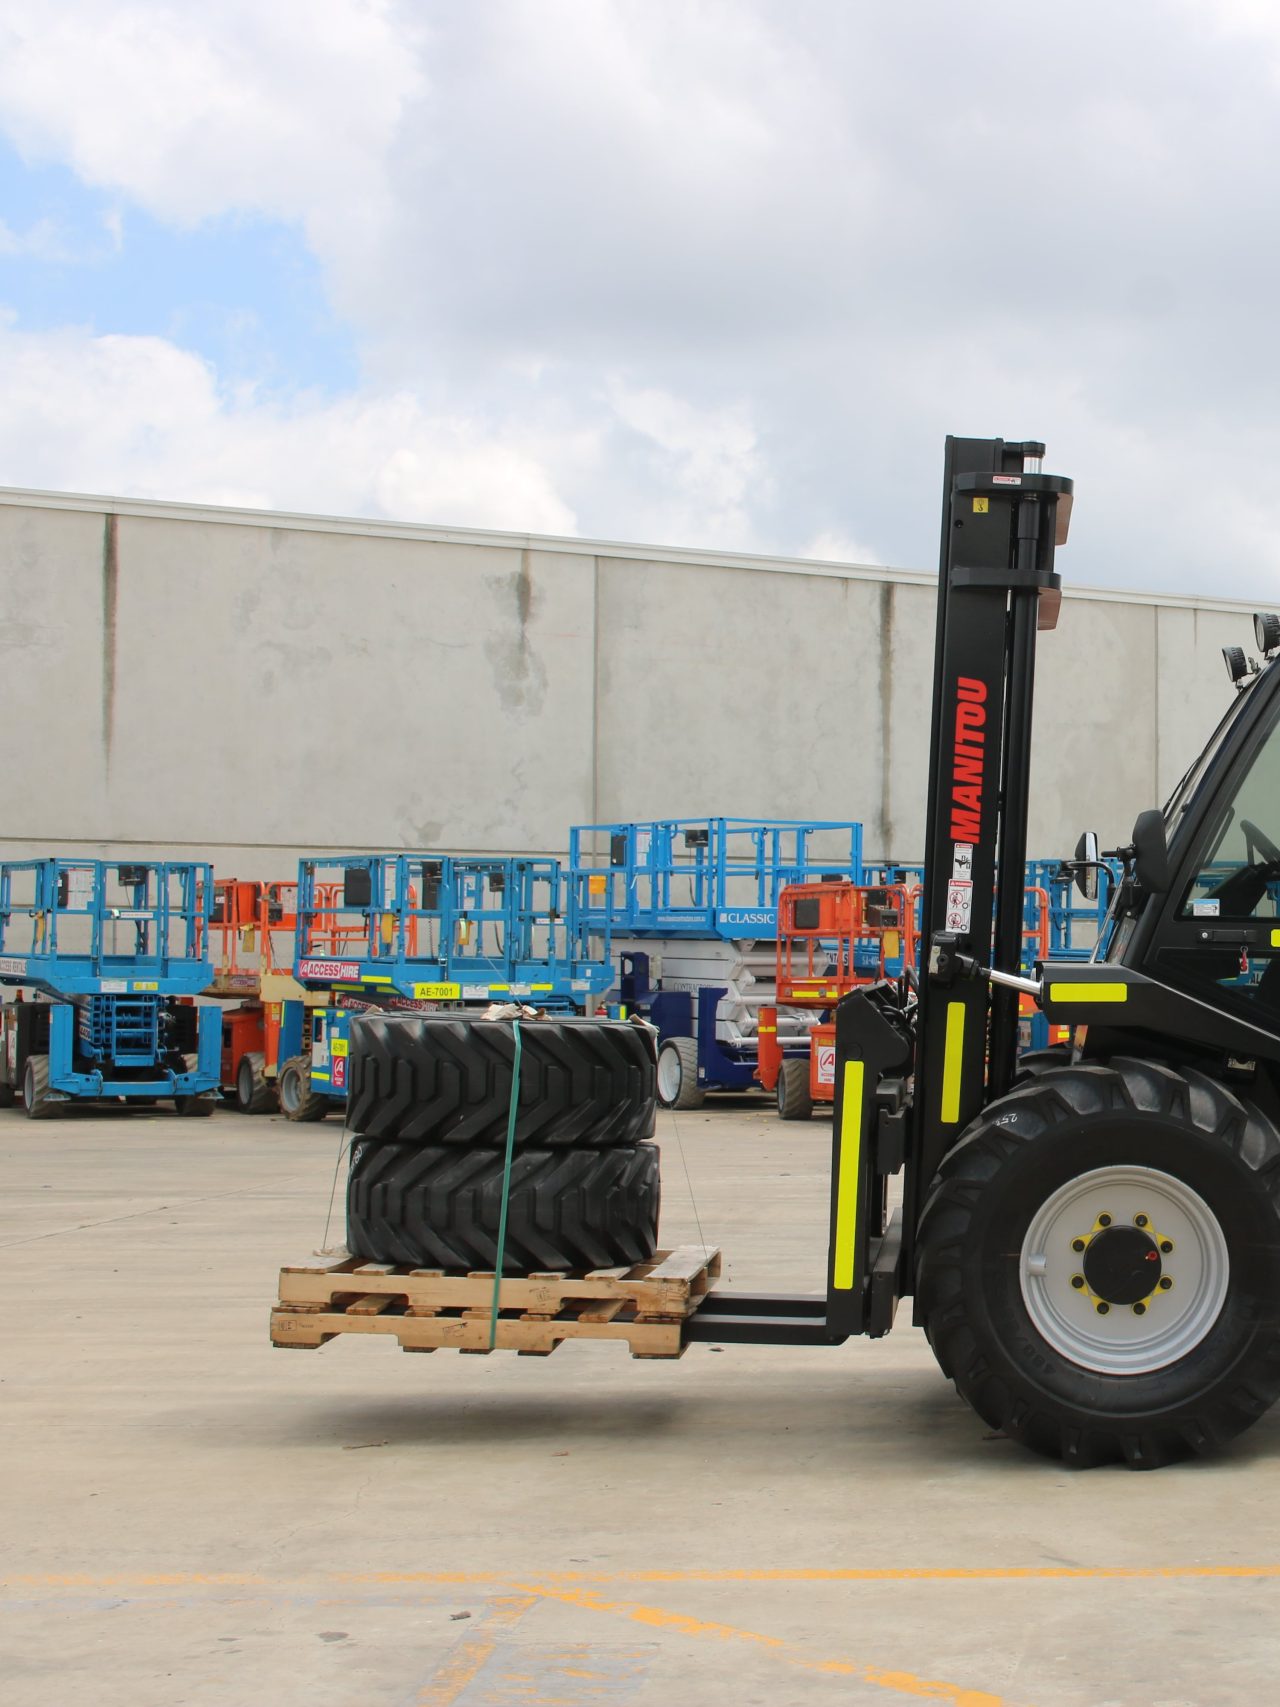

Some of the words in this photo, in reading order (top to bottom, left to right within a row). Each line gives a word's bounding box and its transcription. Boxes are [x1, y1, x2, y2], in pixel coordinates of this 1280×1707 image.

[950, 677, 987, 844] MANITOU
[728, 913, 775, 923] CLASSIC
[308, 963, 339, 977] ACCESS
[341, 965, 359, 979] HIRE
[420, 988, 453, 997] AE-7001
